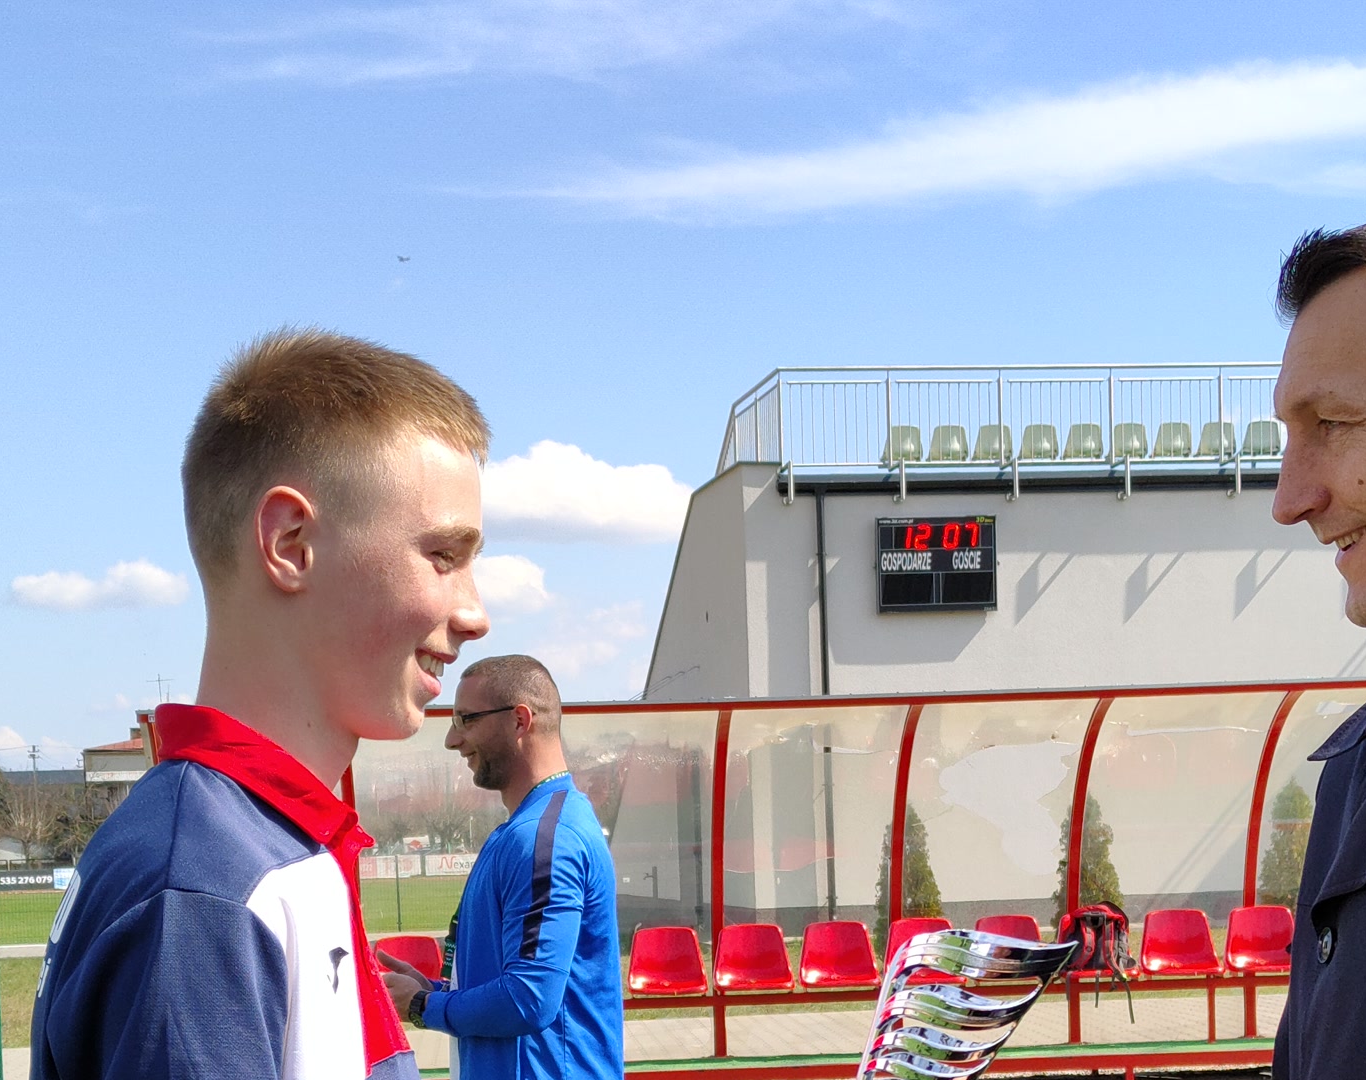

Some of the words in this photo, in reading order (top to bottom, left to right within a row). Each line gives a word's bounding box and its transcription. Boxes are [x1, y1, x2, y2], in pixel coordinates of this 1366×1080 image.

[904, 523, 932, 550] 12
[942, 522, 979, 550] 07
[881, 552, 932, 571] GOSPODARZE
[952, 548, 982, 570] GOŚCIE
[0, 876, 16, 885] 535
[18, 876, 34, 884] 276
[36, 875, 53, 884] 079
